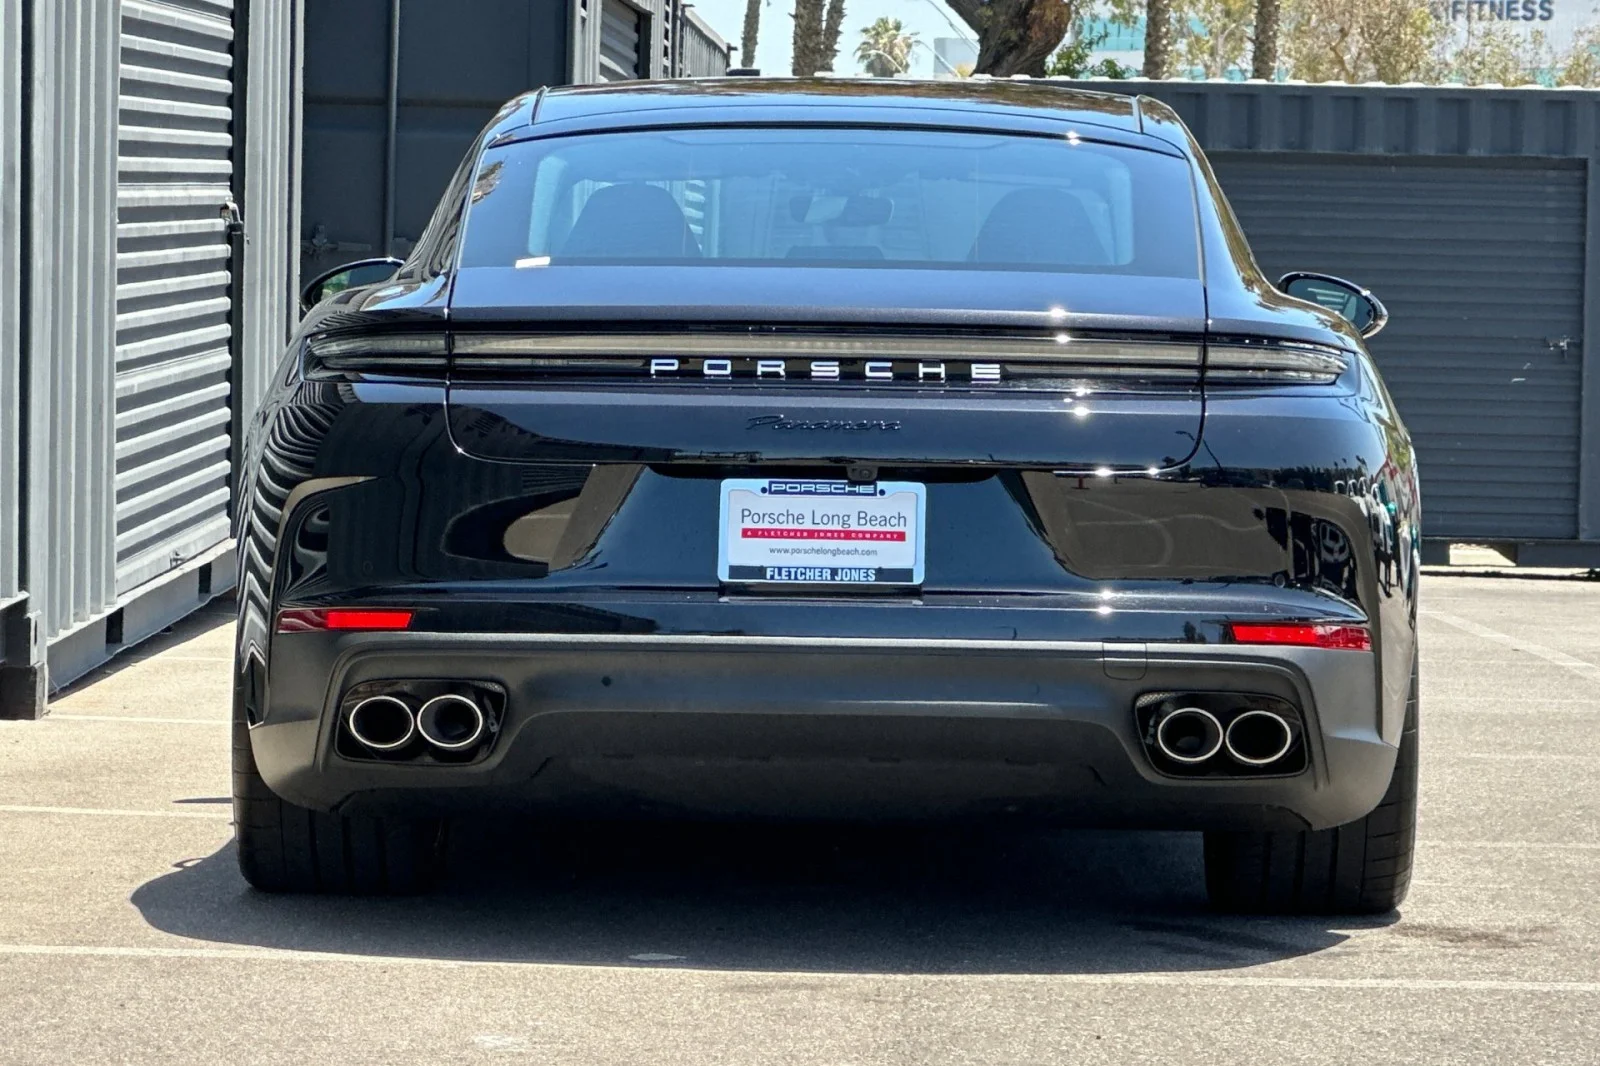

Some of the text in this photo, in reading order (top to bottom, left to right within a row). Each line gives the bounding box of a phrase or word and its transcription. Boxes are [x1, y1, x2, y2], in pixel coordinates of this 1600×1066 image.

[1451, 0, 1555, 21] FITNESS
[650, 358, 1001, 380] PORSCHE
[745, 414, 902, 430] Panamera
[771, 483, 875, 494] PORSCHE
[741, 508, 907, 529] Porsche Long Beach
[769, 547, 878, 557] www.porschelongbeach.com
[766, 567, 876, 581] FLETCHER JONES
